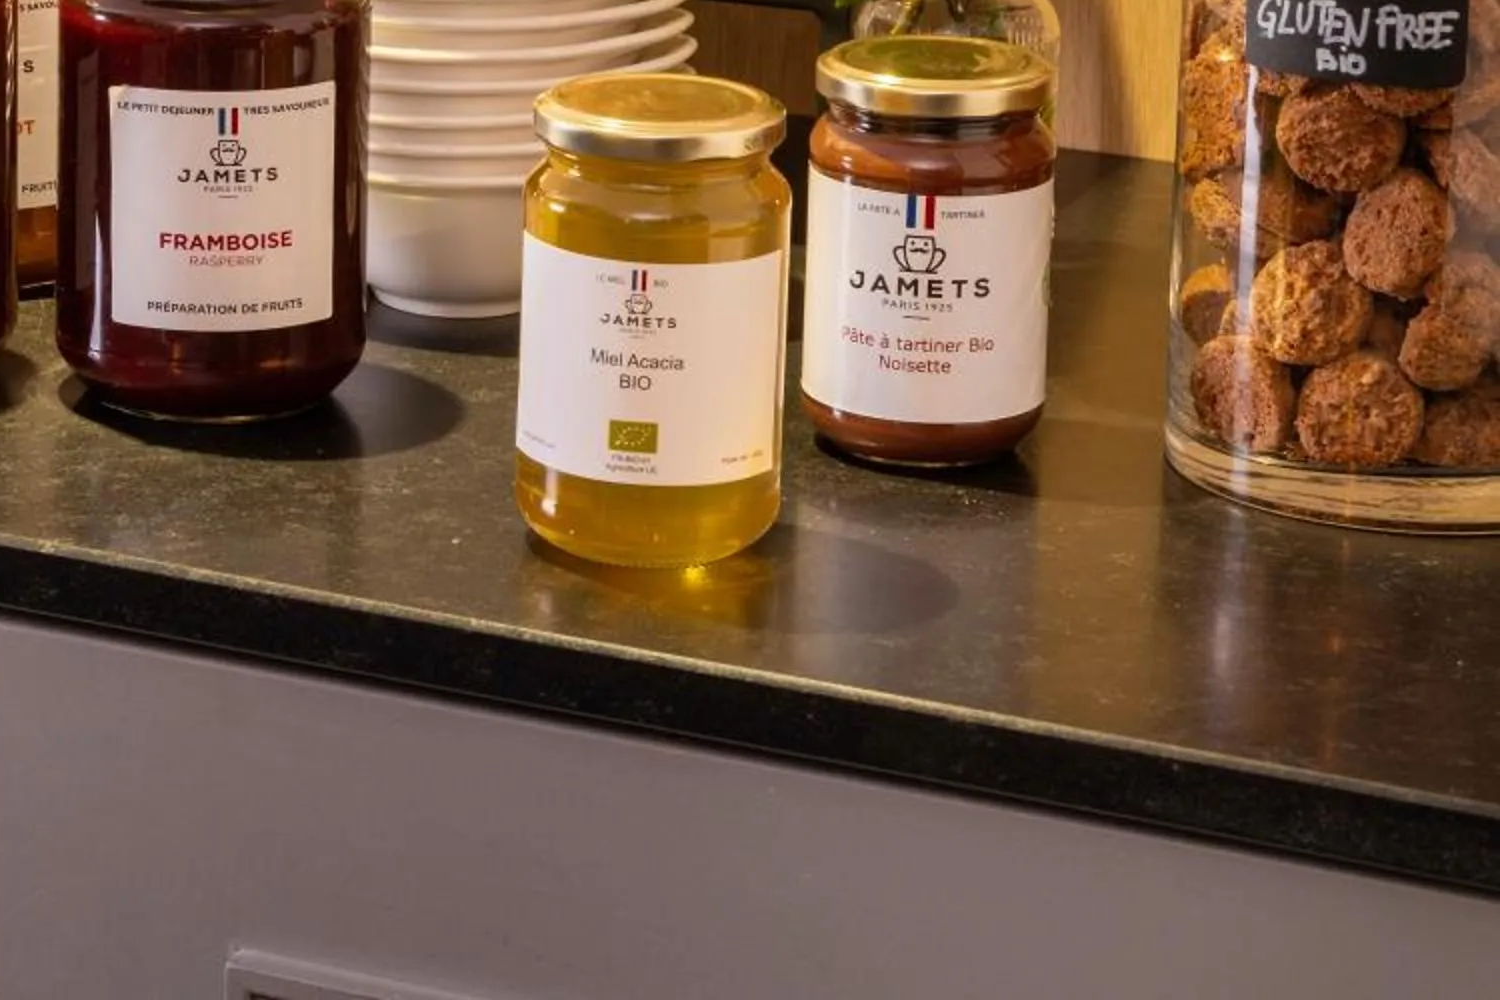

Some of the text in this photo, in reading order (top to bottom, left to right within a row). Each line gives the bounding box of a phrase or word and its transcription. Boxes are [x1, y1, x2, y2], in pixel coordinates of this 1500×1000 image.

[1375, 3, 1460, 50] FREE
[177, 167, 279, 183] JAMETS
[159, 230, 293, 251] FRAMBOISE
[850, 271, 990, 299] JAMETS
[241, 303, 259, 313] DE
[261, 298, 303, 312] FRUITS
[883, 299, 921, 310] PARIS
[600, 313, 677, 329] JAMETS
[879, 333, 890, 349] à
[897, 338, 964, 353] tartiner
[969, 337, 995, 352] Bio
[591, 348, 686, 371] Miel Acacia
[879, 355, 952, 374] Noisette
[619, 375, 652, 391] BIO
